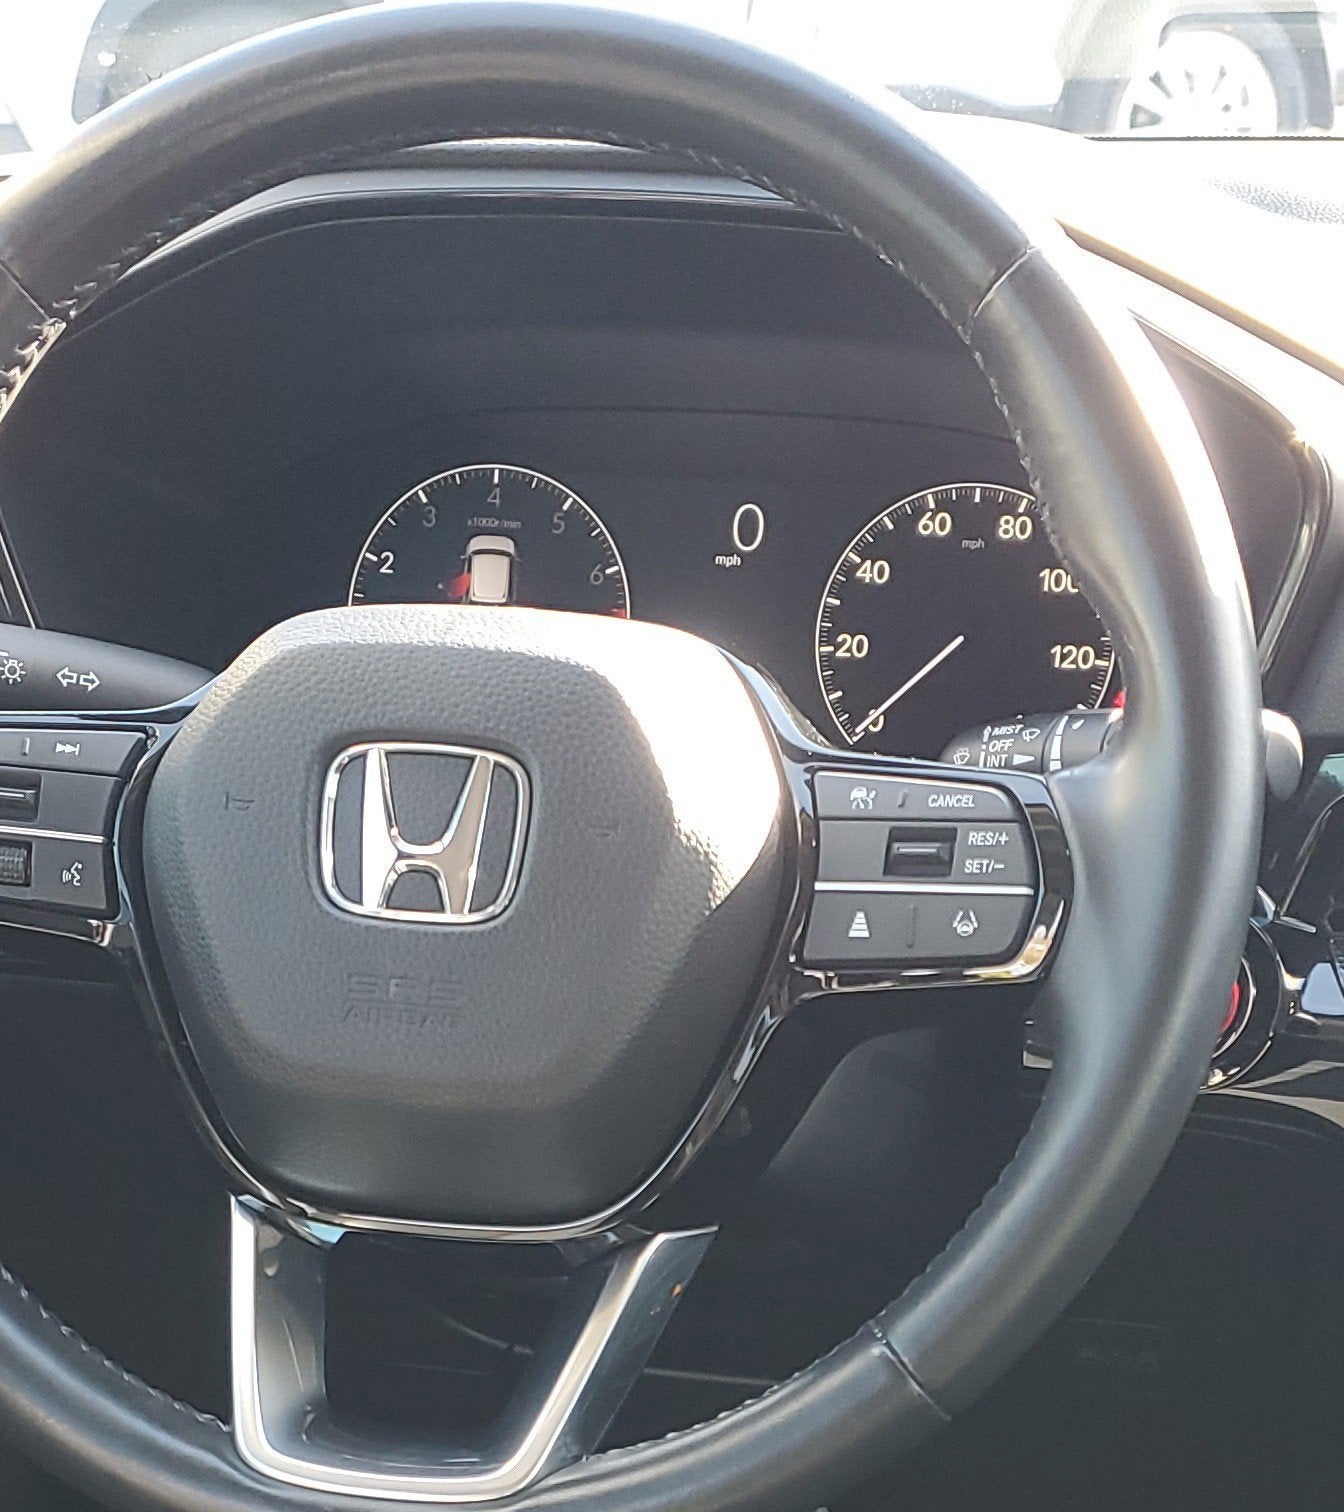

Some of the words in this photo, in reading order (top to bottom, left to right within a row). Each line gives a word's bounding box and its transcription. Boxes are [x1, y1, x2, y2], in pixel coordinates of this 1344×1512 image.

[487, 488, 501, 507] 4
[423, 506, 436, 527] 3
[552, 513, 565, 533] 5
[918, 512, 952, 535] 60
[732, 503, 765, 552] 0
[999, 515, 1032, 540] 80
[962, 539, 984, 549] mph
[379, 551, 394, 573] 2
[714, 554, 742, 568] mph
[590, 564, 604, 584] 6
[856, 560, 890, 583] 40
[835, 634, 869, 658] 20
[1050, 645, 1094, 669] 120
[992, 724, 1024, 736] MIST
[989, 739, 1014, 752] OFF
[987, 754, 1008, 767] INT
[928, 794, 975, 809] CANCEL
[968, 831, 1009, 847] RES/+
